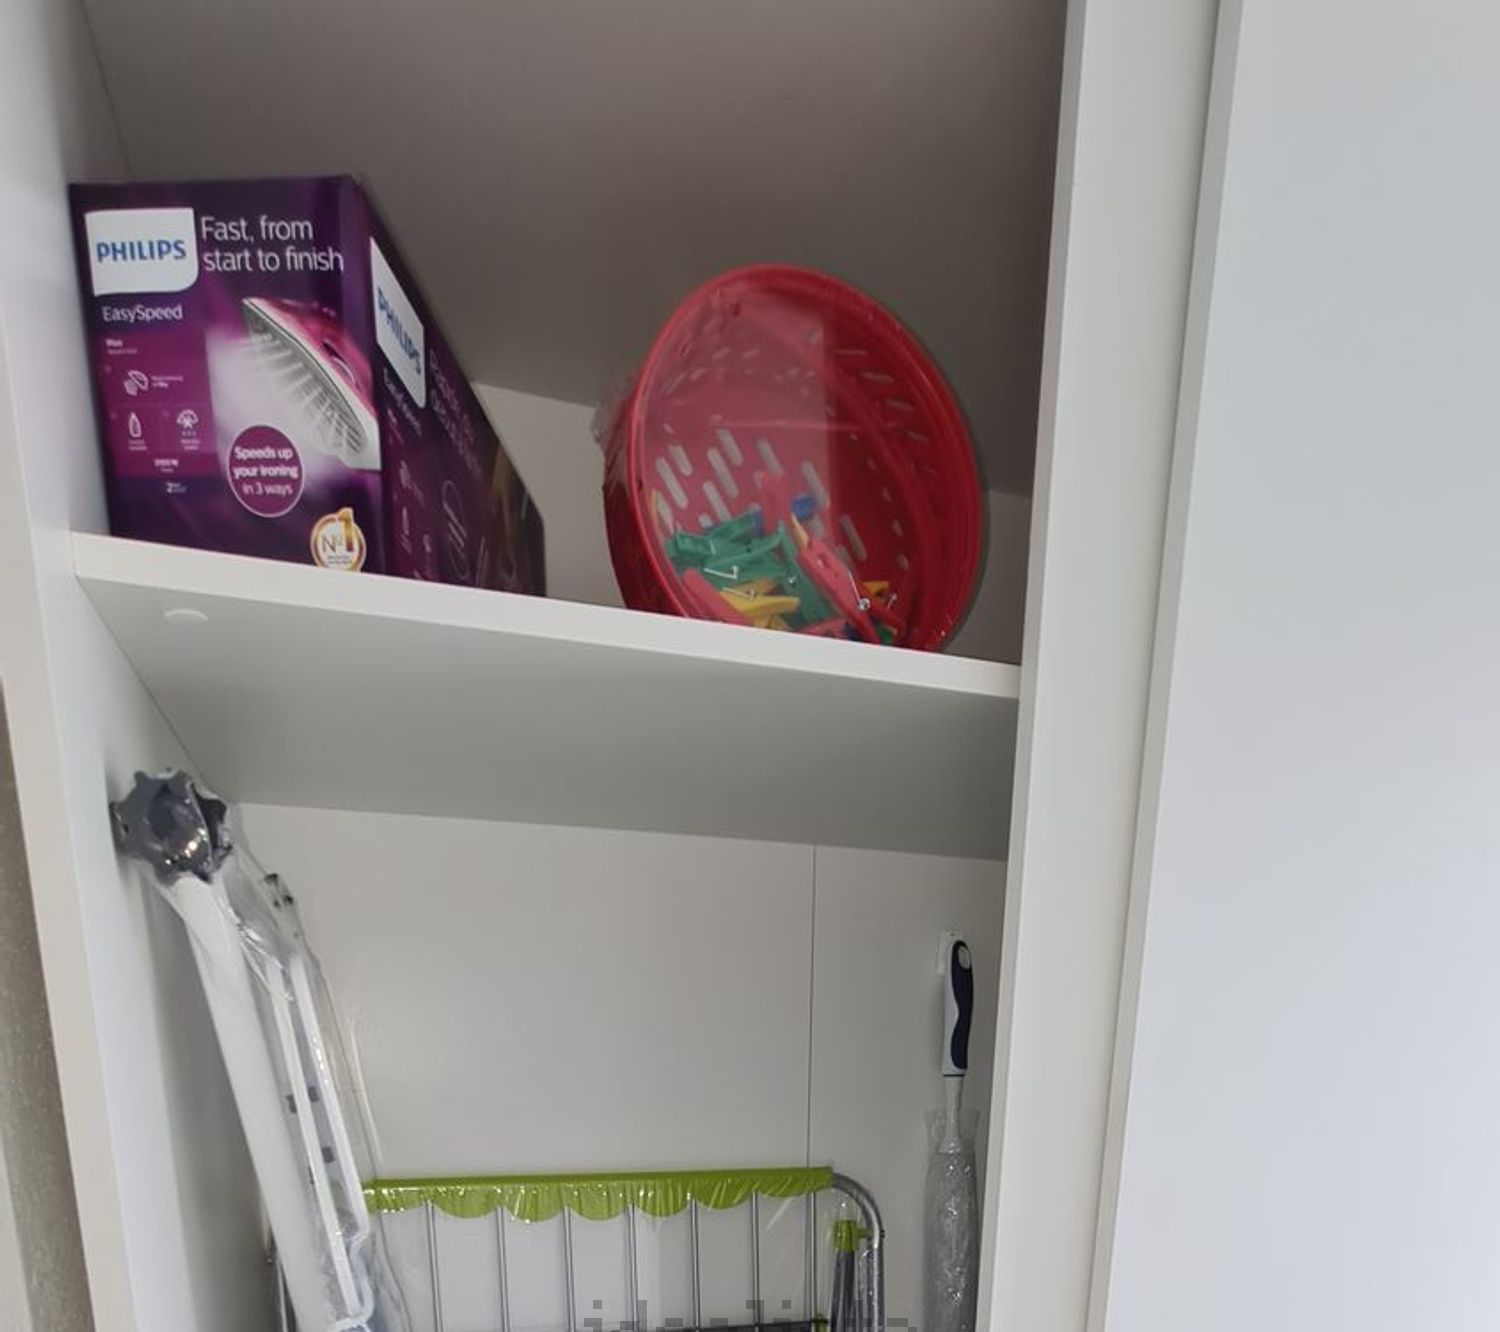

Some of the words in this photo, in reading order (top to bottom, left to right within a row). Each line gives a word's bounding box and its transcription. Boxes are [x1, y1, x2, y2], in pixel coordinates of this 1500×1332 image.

[201, 216, 254, 243] Fast,
[260, 215, 313, 241] from
[96, 239, 186, 263] PHILIPS
[203, 249, 251, 272] start
[258, 251, 281, 271] to
[285, 246, 344, 272] finish
[102, 304, 183, 323] EasySpeed
[377, 285, 421, 376] PHILIPS
[234, 446, 276, 460] Speeds
[278, 447, 294, 460] up
[232, 466, 258, 480] your
[260, 465, 299, 479] ironing
[242, 483, 254, 495] in
[255, 481, 263, 495] 3
[264, 484, 293, 497] ways
